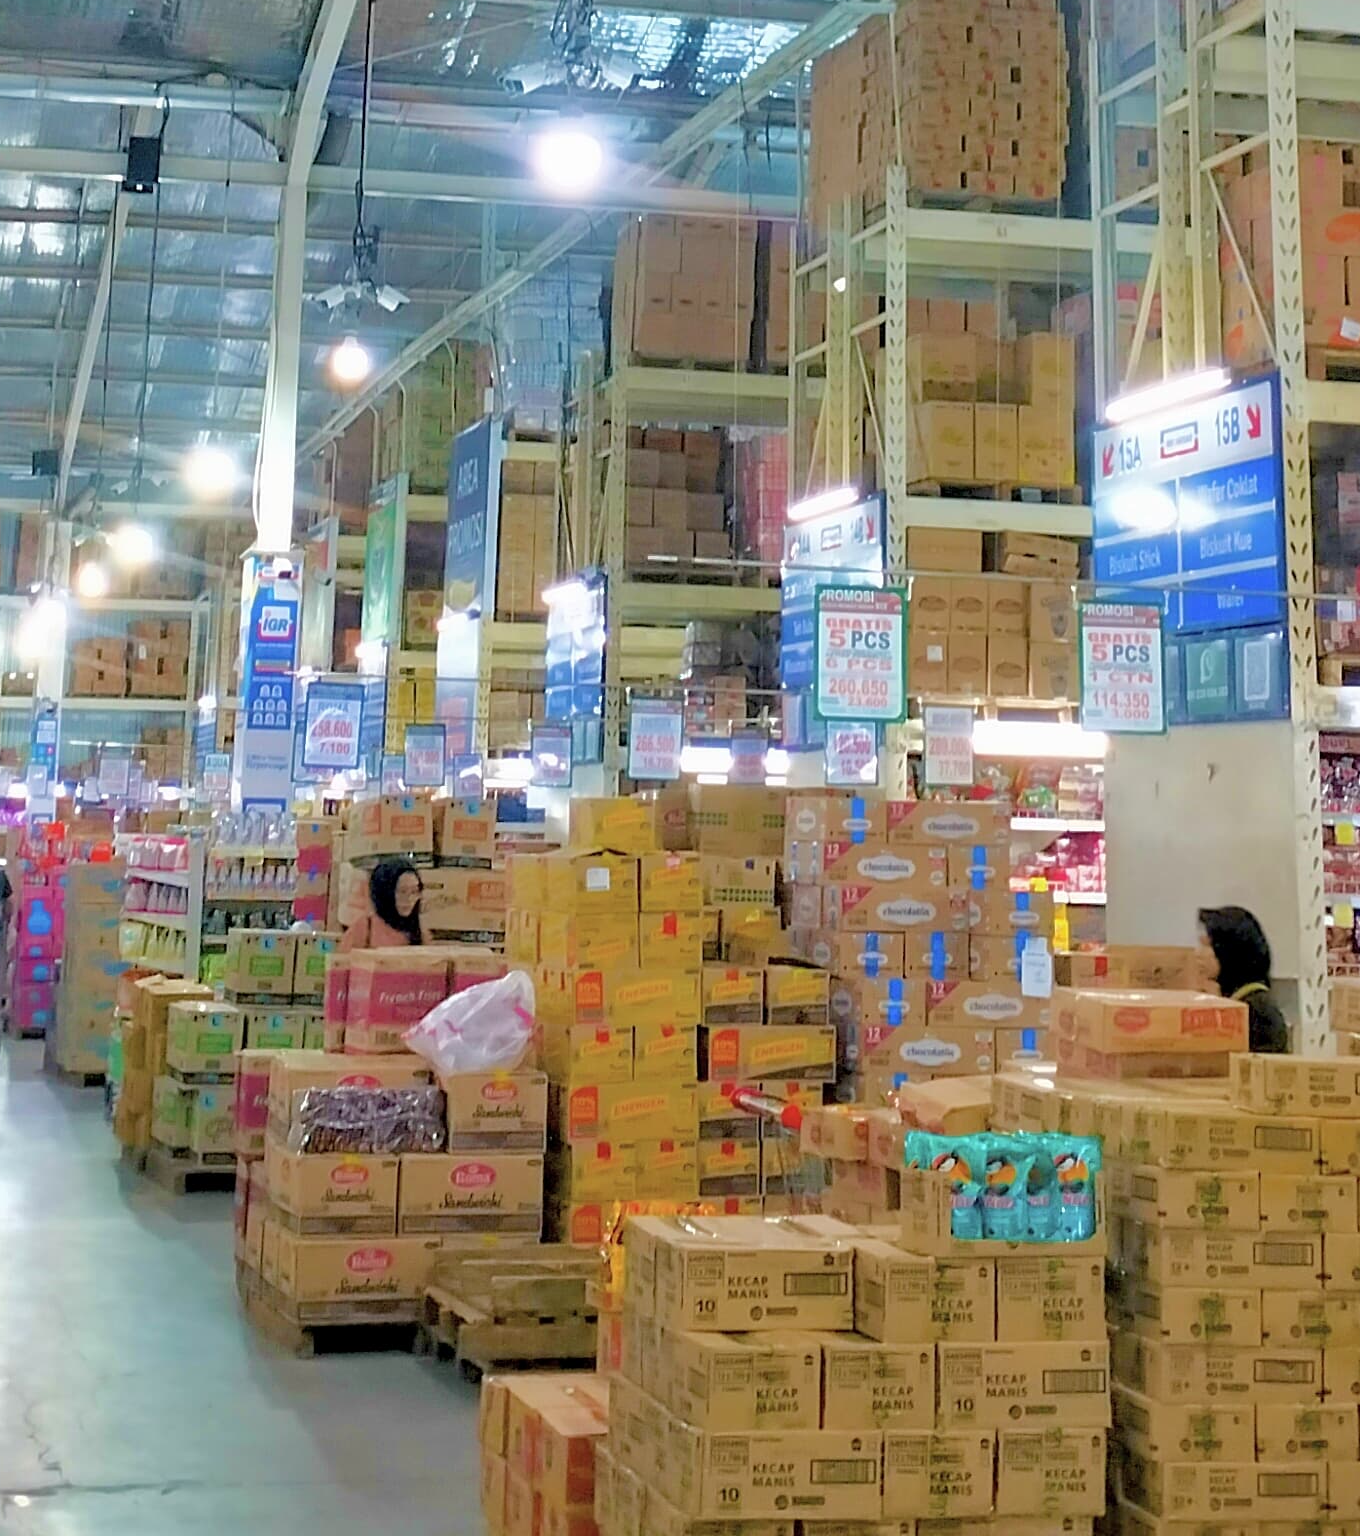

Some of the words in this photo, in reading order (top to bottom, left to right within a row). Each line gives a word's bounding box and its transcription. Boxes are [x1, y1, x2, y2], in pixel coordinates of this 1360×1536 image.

[1215, 406, 1241, 447] 15B
[1118, 435, 1142, 475] 15A
[828, 630, 846, 648] 5
[851, 630, 891, 650] PCS
[1091, 644, 1108, 662] 5
[1112, 644, 1151, 663] PCS
[728, 1275, 769, 1287] KECAP
[728, 1289, 769, 1300] MANIS
[695, 1299, 716, 1313] 10
[931, 1298, 974, 1310] KECAP
[1042, 1297, 1085, 1309] KECAP
[931, 1311, 975, 1324] MANIS
[1042, 1310, 1086, 1323] MANIS
[985, 1373, 1028, 1386] KECAP
[755, 1387, 799, 1400] KECAP
[872, 1385, 915, 1397] KECAP
[985, 1386, 1029, 1399] MANIS
[755, 1400, 800, 1414] MANIS
[872, 1399, 915, 1411] MANIS
[953, 1398, 975, 1413] 10
[752, 1463, 796, 1475] KECAP
[1044, 1468, 1087, 1481] KECAP
[752, 1476, 797, 1488] MANIS
[929, 1470, 973, 1483] KECAP
[718, 1487, 740, 1502] 10
[929, 1484, 974, 1497] MANIS
[1044, 1482, 1088, 1495] MANIS
